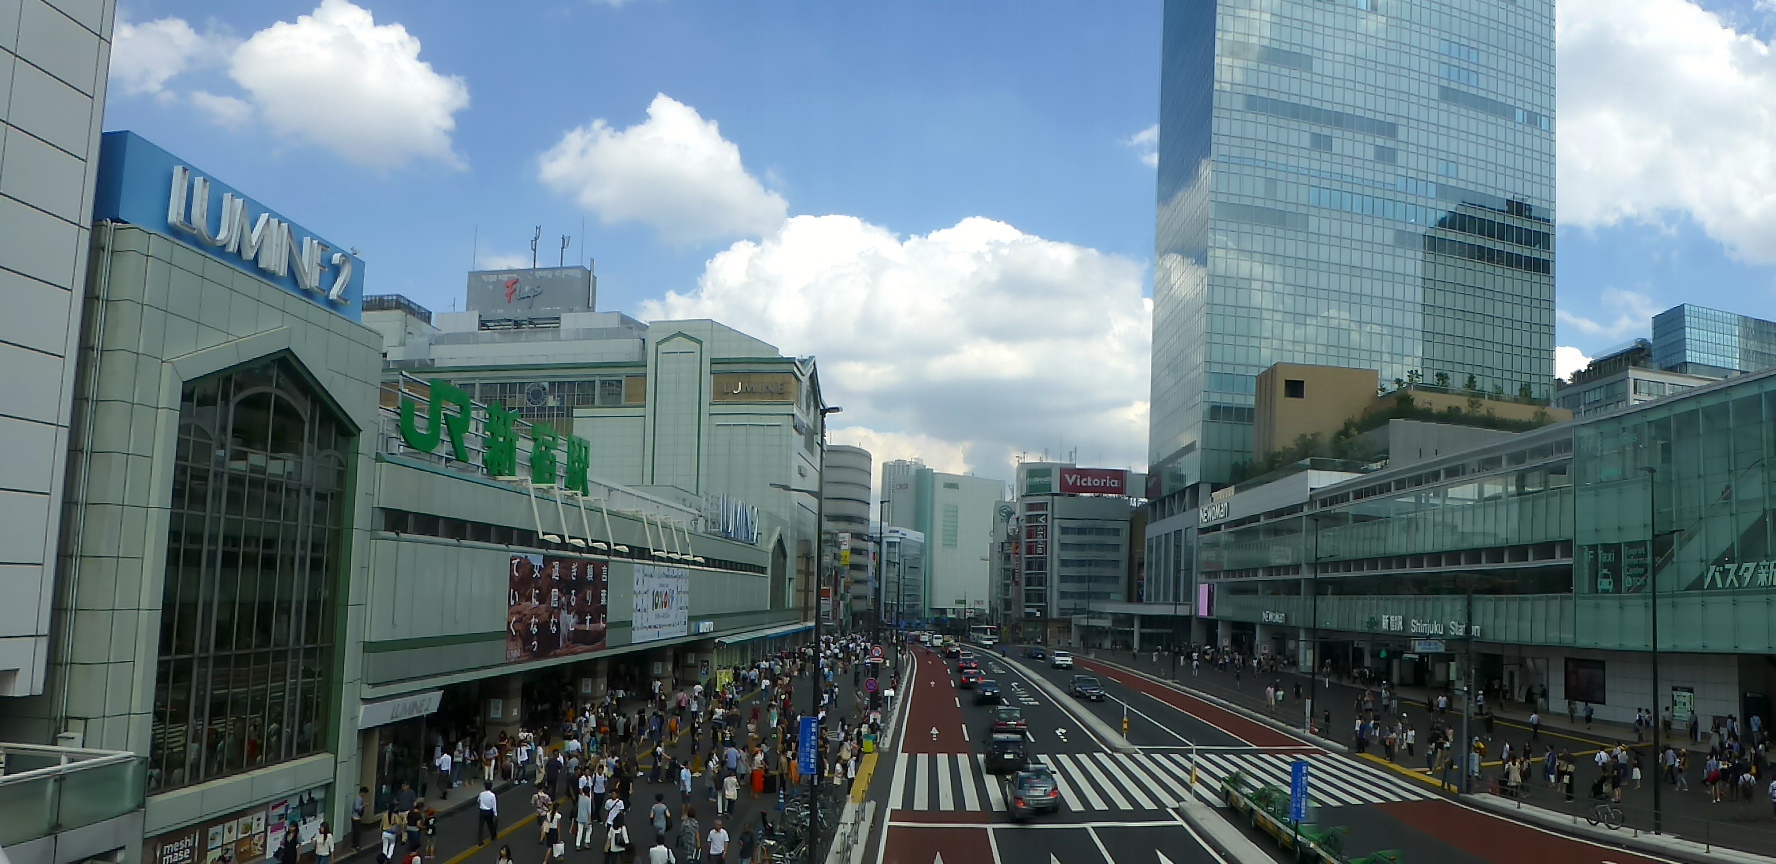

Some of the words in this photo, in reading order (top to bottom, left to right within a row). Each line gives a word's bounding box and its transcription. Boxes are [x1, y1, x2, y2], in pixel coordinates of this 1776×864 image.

[724, 382, 785, 395] LUMINE
[1064, 473, 1120, 488] Victoria
[510, 558, 521, 637] ていく
[1411, 619, 1445, 636] Shinjuku
[1449, 620, 1481, 638] Statn
[163, 833, 194, 854] meshi
[162, 848, 191, 864] mase
